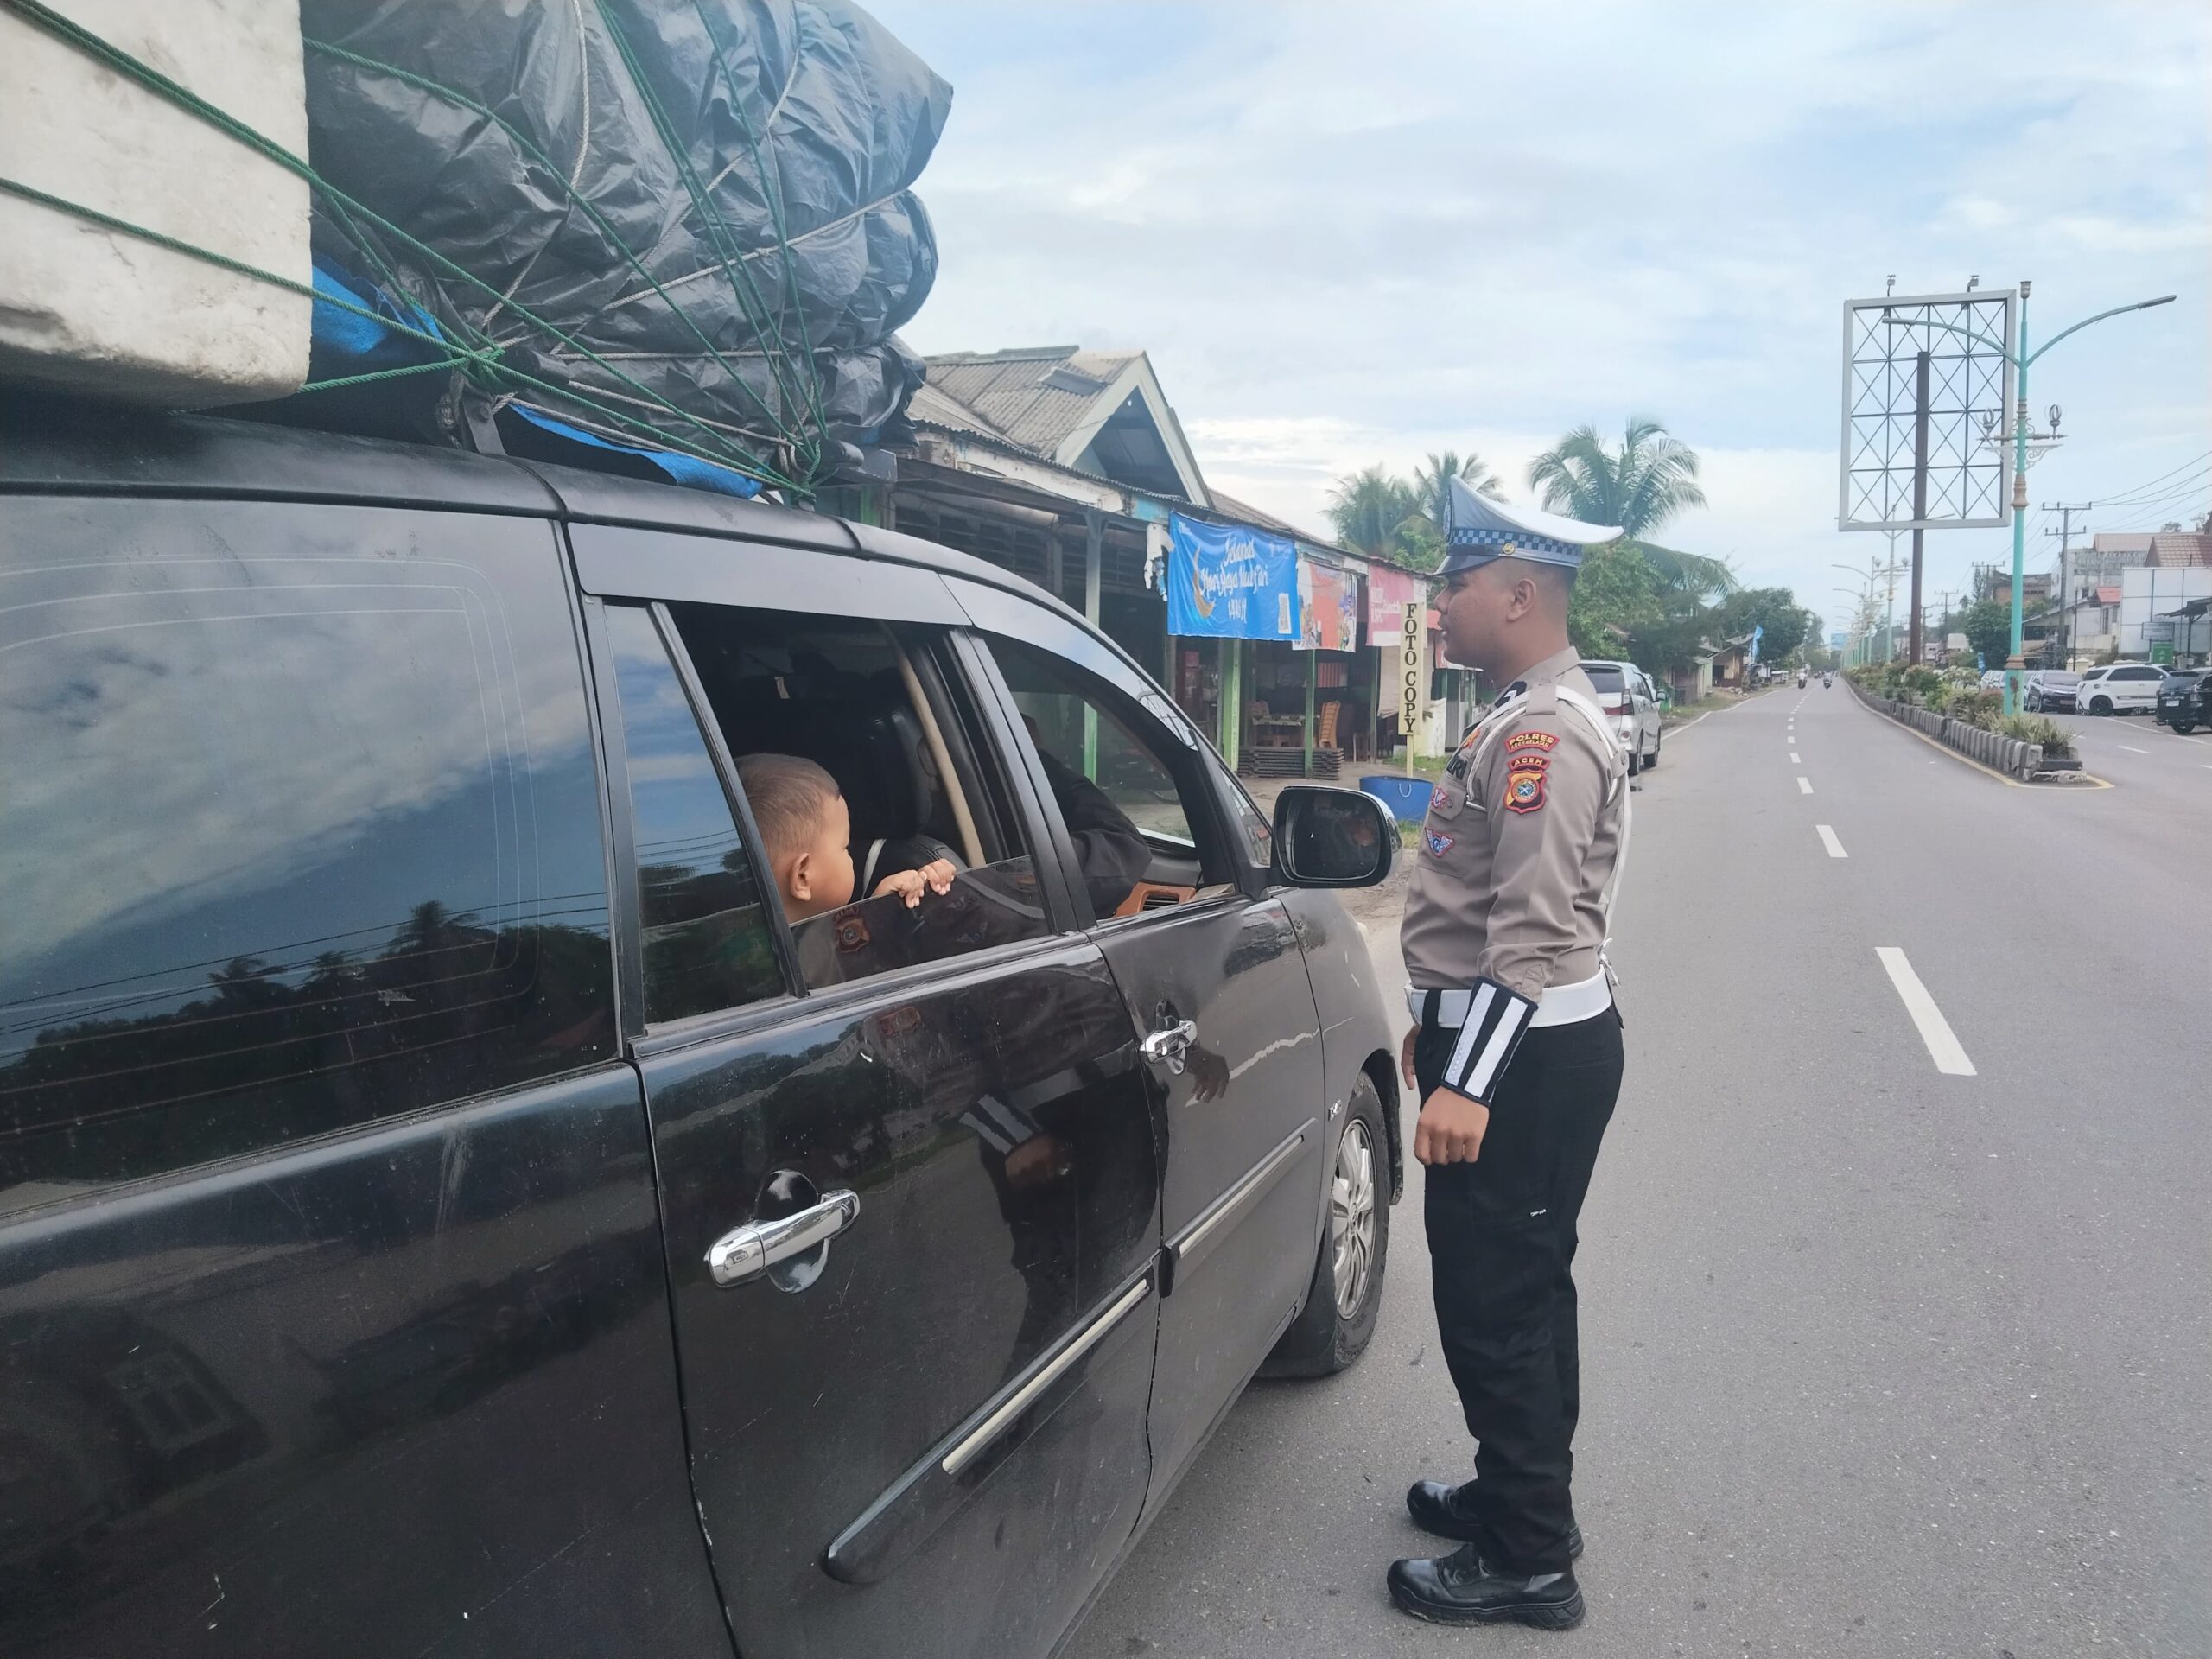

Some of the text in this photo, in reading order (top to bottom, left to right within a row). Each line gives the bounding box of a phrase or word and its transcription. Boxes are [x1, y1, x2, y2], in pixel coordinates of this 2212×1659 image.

[1404, 603, 1417, 733] FOTO COPY
[1509, 733, 1554, 745] POLRES
[1510, 739, 1550, 750] ACEH SELATAN
[1514, 757, 1543, 766] ACEH
